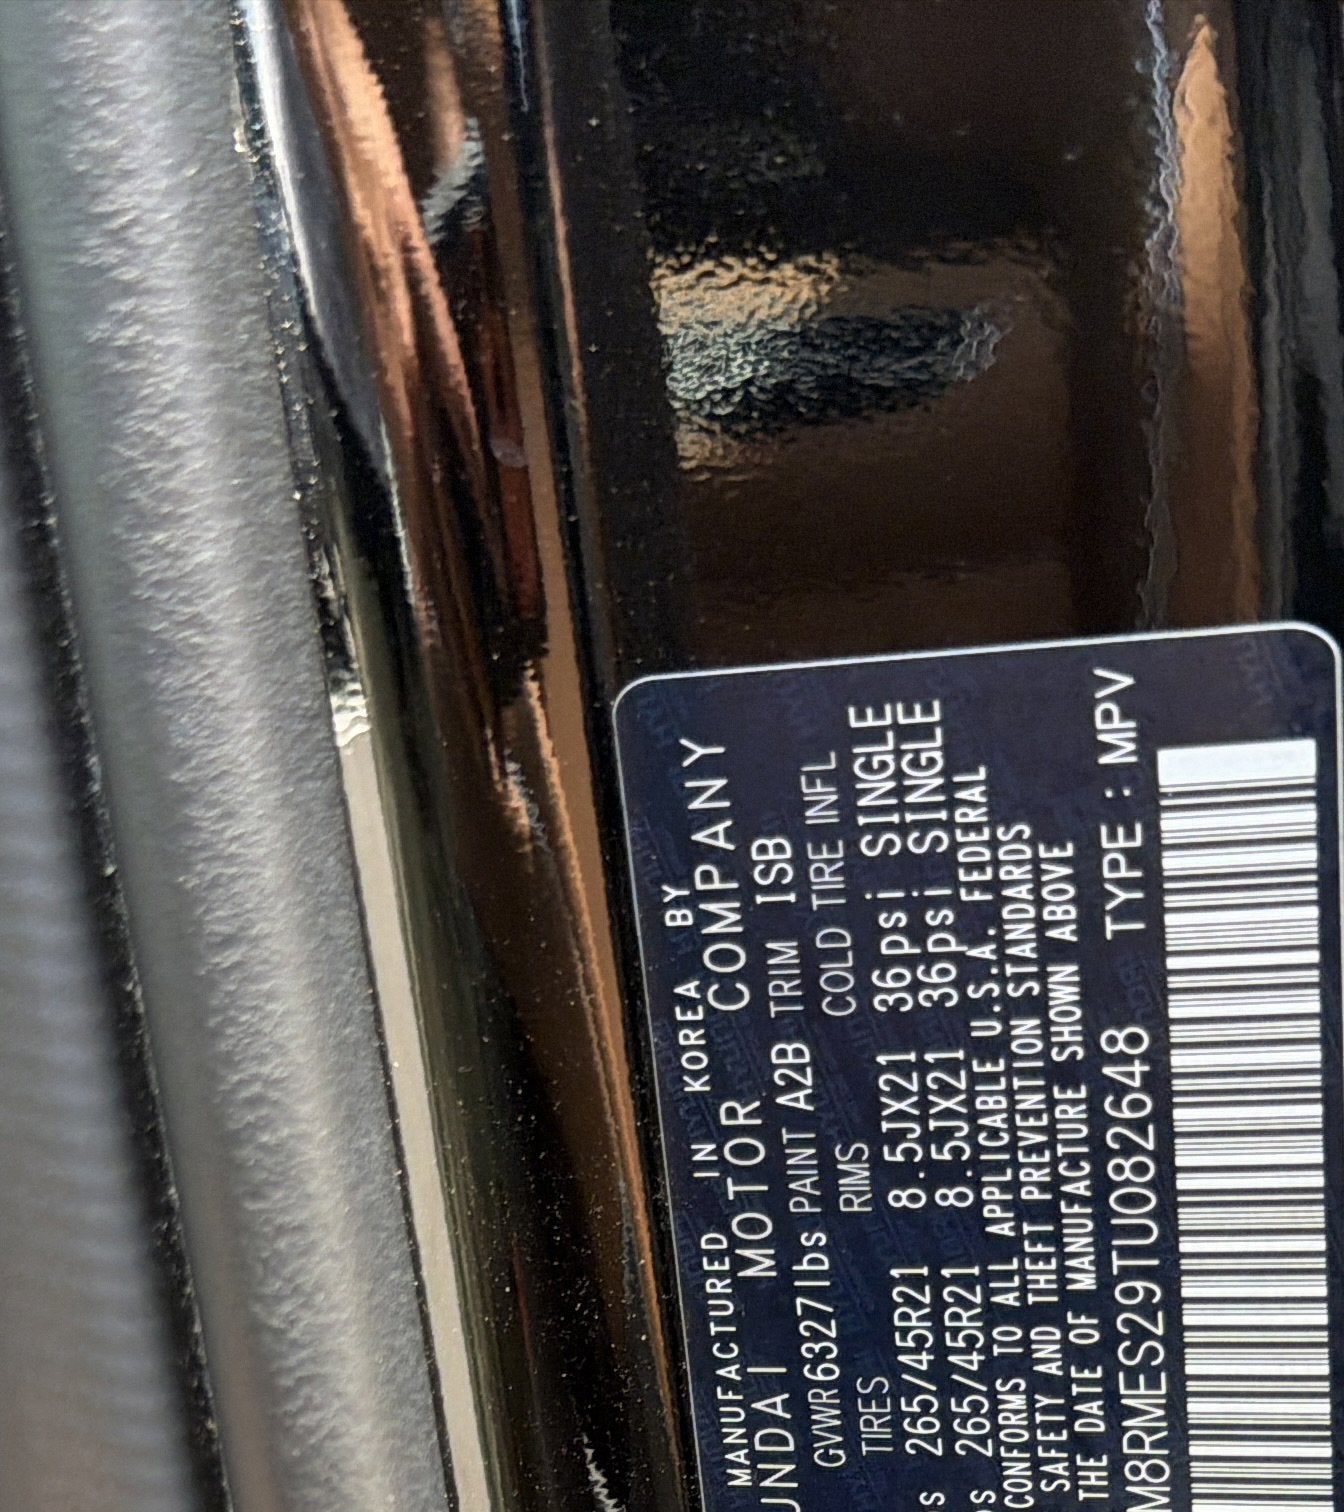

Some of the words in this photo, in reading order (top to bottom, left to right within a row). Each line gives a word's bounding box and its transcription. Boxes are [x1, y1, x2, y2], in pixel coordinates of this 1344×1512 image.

[1093, 668, 1138, 765] MPV
[800, 751, 840, 825] INFL
[847, 703, 902, 857] SINGLE
[896, 699, 950, 854] SINGLE
[679, 738, 750, 1011] COMPANY
[750, 836, 796, 905] ISB
[806, 839, 847, 911] TIRE
[952, 765, 994, 902] FEDERAL
[1100, 822, 1146, 941] TYPE
[661, 884, 694, 927] BY
[996, 823, 1040, 998] STANDARDS
[1038, 842, 1078, 942] ABOVE
[765, 941, 804, 1018] TRIM
[815, 927, 857, 1017] COLD
[964, 928, 1003, 1037] U.S.A.
[1046, 964, 1085, 1062] SHOWN
[673, 980, 711, 1092] KOREA
[770, 1042, 815, 1111] A2B
[875, 1051, 927, 1209] 8.5JX21
[923, 1048, 975, 1208] 8.5JX21
[971, 1058, 1016, 1237] APPLICABLE
[1009, 1018, 1053, 1200] PREVENTION
[690, 1143, 720, 1178] IN
[719, 1100, 778, 1277] MOTOR
[781, 1127, 822, 1213] PAINT
[834, 1142, 873, 1212] RIMS
[1052, 1084, 1097, 1290] MANUFACTURE
[987, 1257, 1021, 1307] ALL
[1022, 1221, 1059, 1305] THEFT
[700, 1232, 753, 1486] MANUFACTURED
[889, 1266, 943, 1457] 265/45R21
[940, 1265, 993, 1458] 265/45R21
[991, 1326, 1024, 1357] TO
[1029, 1326, 1064, 1376] AND
[1066, 1311, 1100, 1345] OF
[807, 1388, 847, 1468] GVWR
[856, 1376, 894, 1456] TIRES
[995, 1378, 1035, 1509] CONFORMS
[1034, 1394, 1071, 1492] SAFETY
[1070, 1365, 1106, 1433] DATE
[1075, 1453, 1109, 1502] THE
